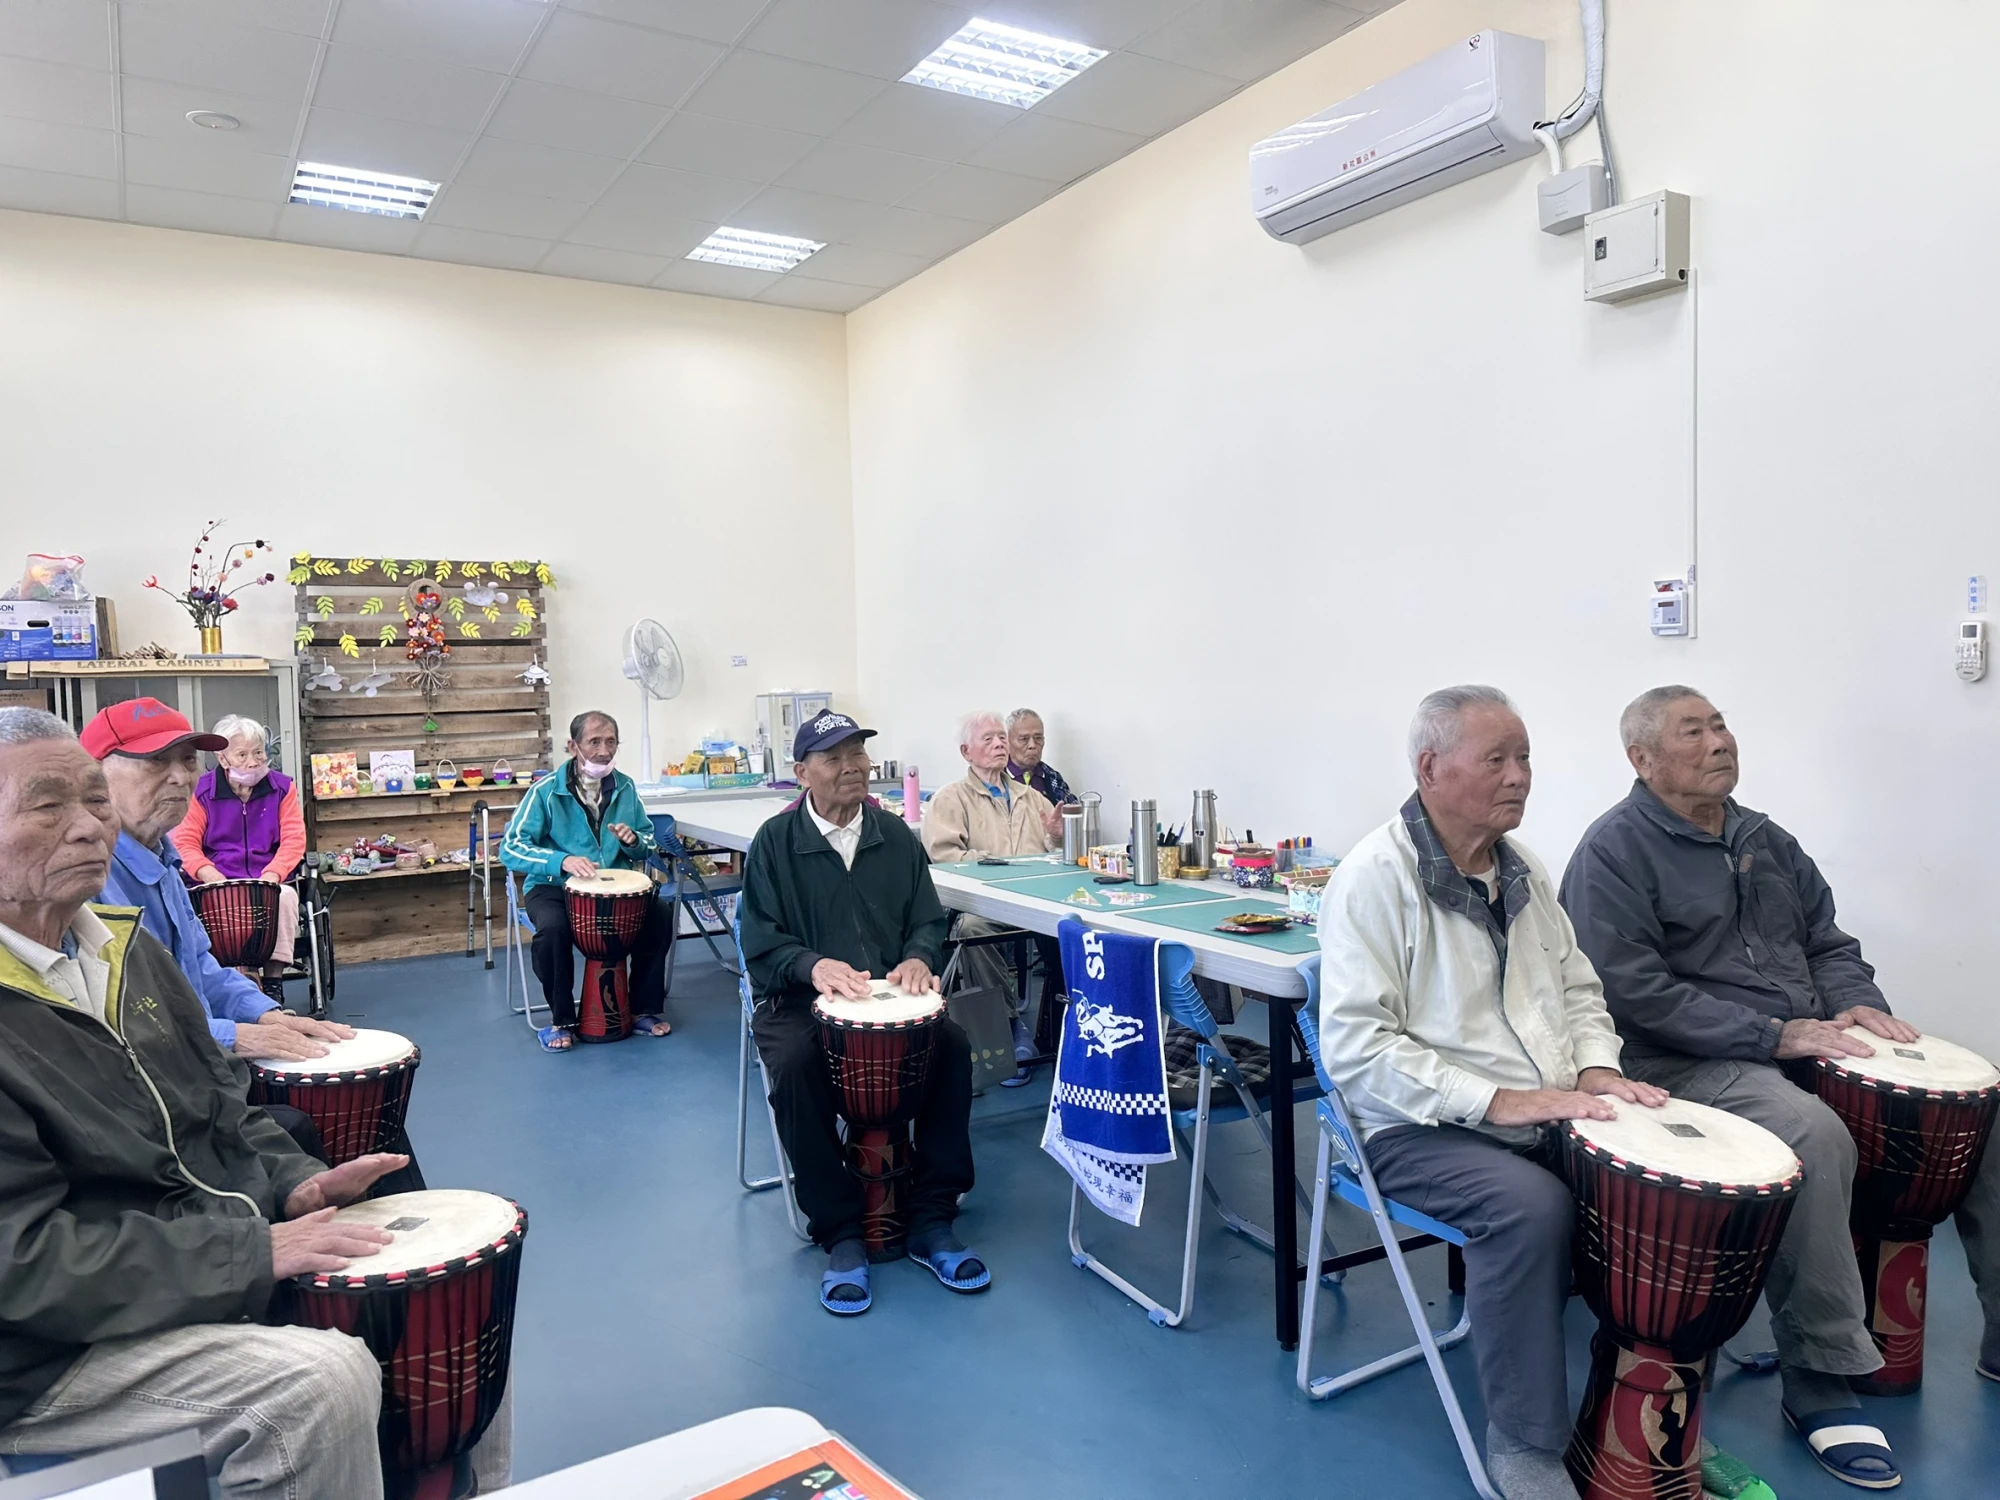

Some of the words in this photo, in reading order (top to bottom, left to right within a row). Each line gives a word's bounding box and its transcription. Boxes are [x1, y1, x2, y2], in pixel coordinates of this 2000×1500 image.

[77, 660, 148, 669] LATERAL
[156, 659, 224, 668] CABINET
[815, 721, 853, 735] TOGETHER
